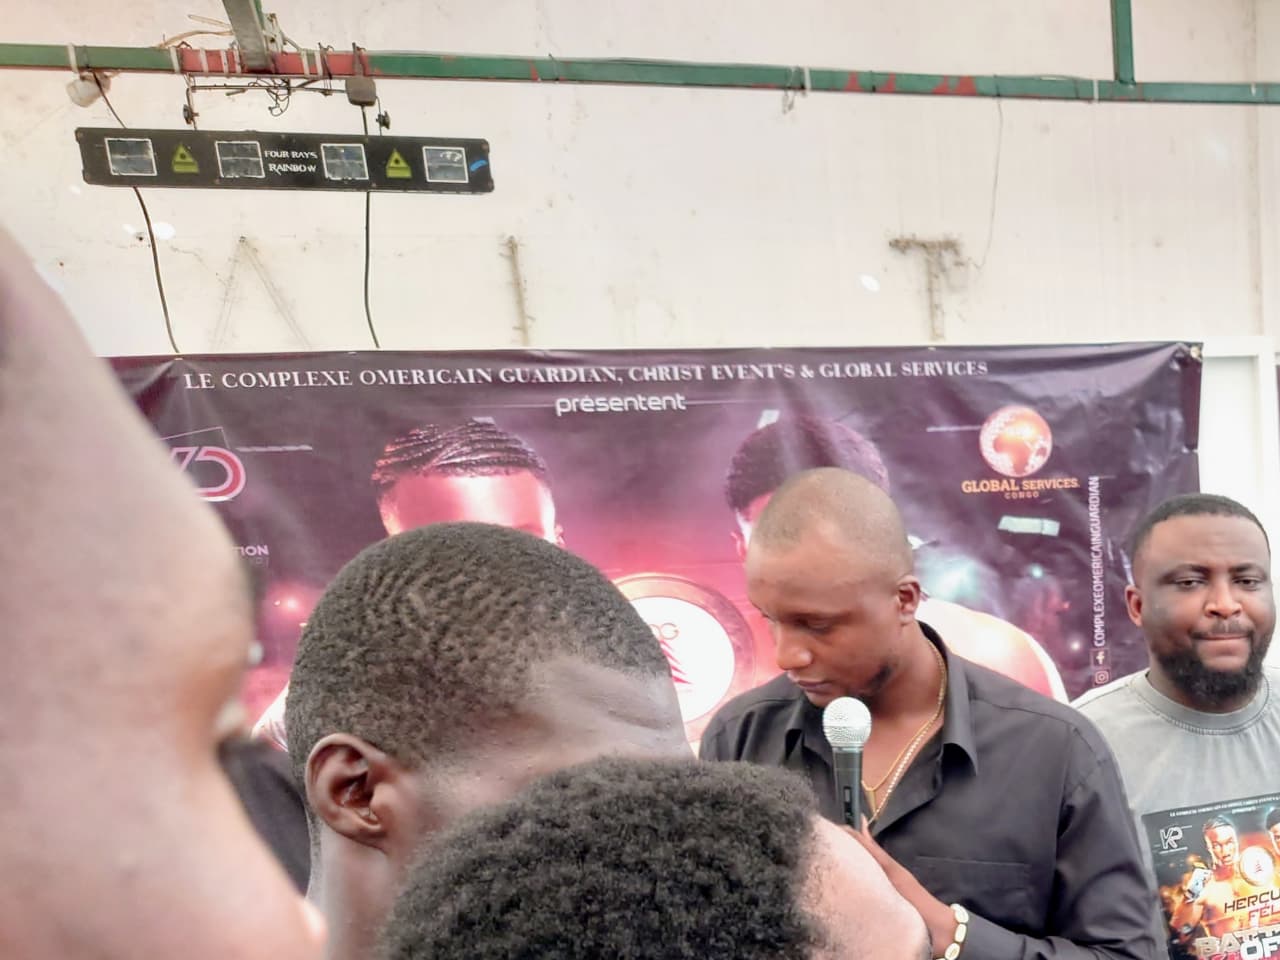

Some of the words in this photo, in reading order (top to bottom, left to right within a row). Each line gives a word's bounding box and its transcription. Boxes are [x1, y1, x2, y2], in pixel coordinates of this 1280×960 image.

[264, 150, 289, 158] FOUR
[291, 151, 318, 159] RAYS
[268, 163, 316, 175] RAINBOW
[184, 373, 215, 389] LE
[222, 369, 353, 388] COMPLEXE
[359, 367, 492, 385] OMERICAIN
[499, 366, 624, 384] GUARDIAN,
[628, 364, 706, 382] CHRIST
[712, 363, 795, 380] EVENT'S
[800, 364, 814, 379] &
[819, 362, 897, 378] GLOBAL
[902, 360, 989, 376] SERVICES
[555, 393, 687, 416] présentent
[962, 479, 1019, 493] GLOBAL
[1004, 491, 1039, 499] CONGO
